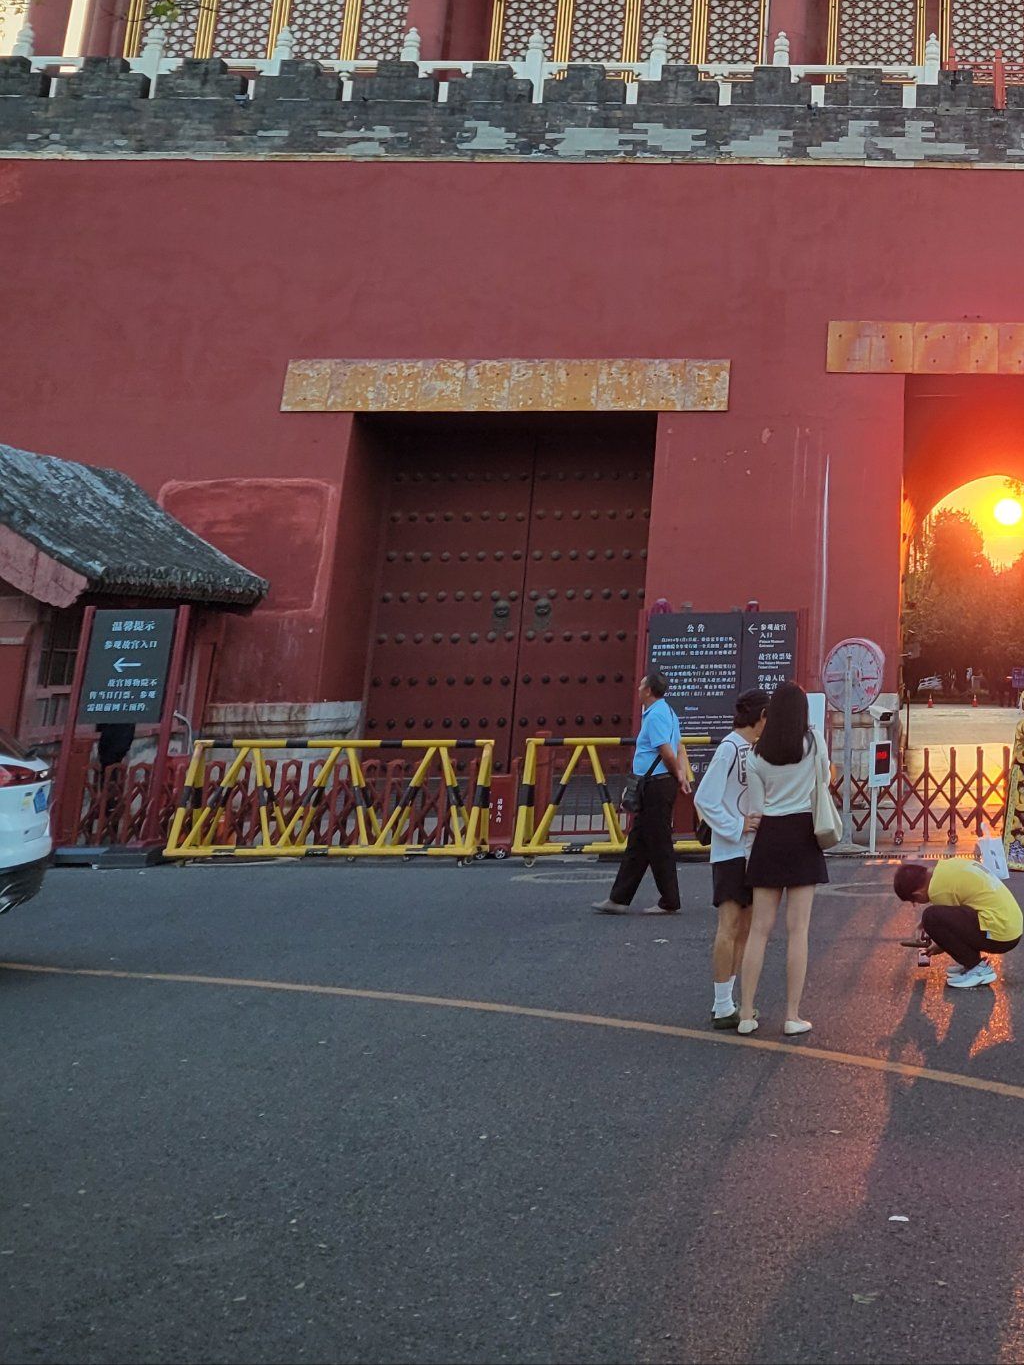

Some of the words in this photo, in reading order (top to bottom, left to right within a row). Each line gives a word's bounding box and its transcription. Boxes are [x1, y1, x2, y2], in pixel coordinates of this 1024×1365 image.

[111, 620, 156, 632] 温馨提示
[687, 623, 705, 632] 公告
[104, 640, 158, 650] 参观故宫入口
